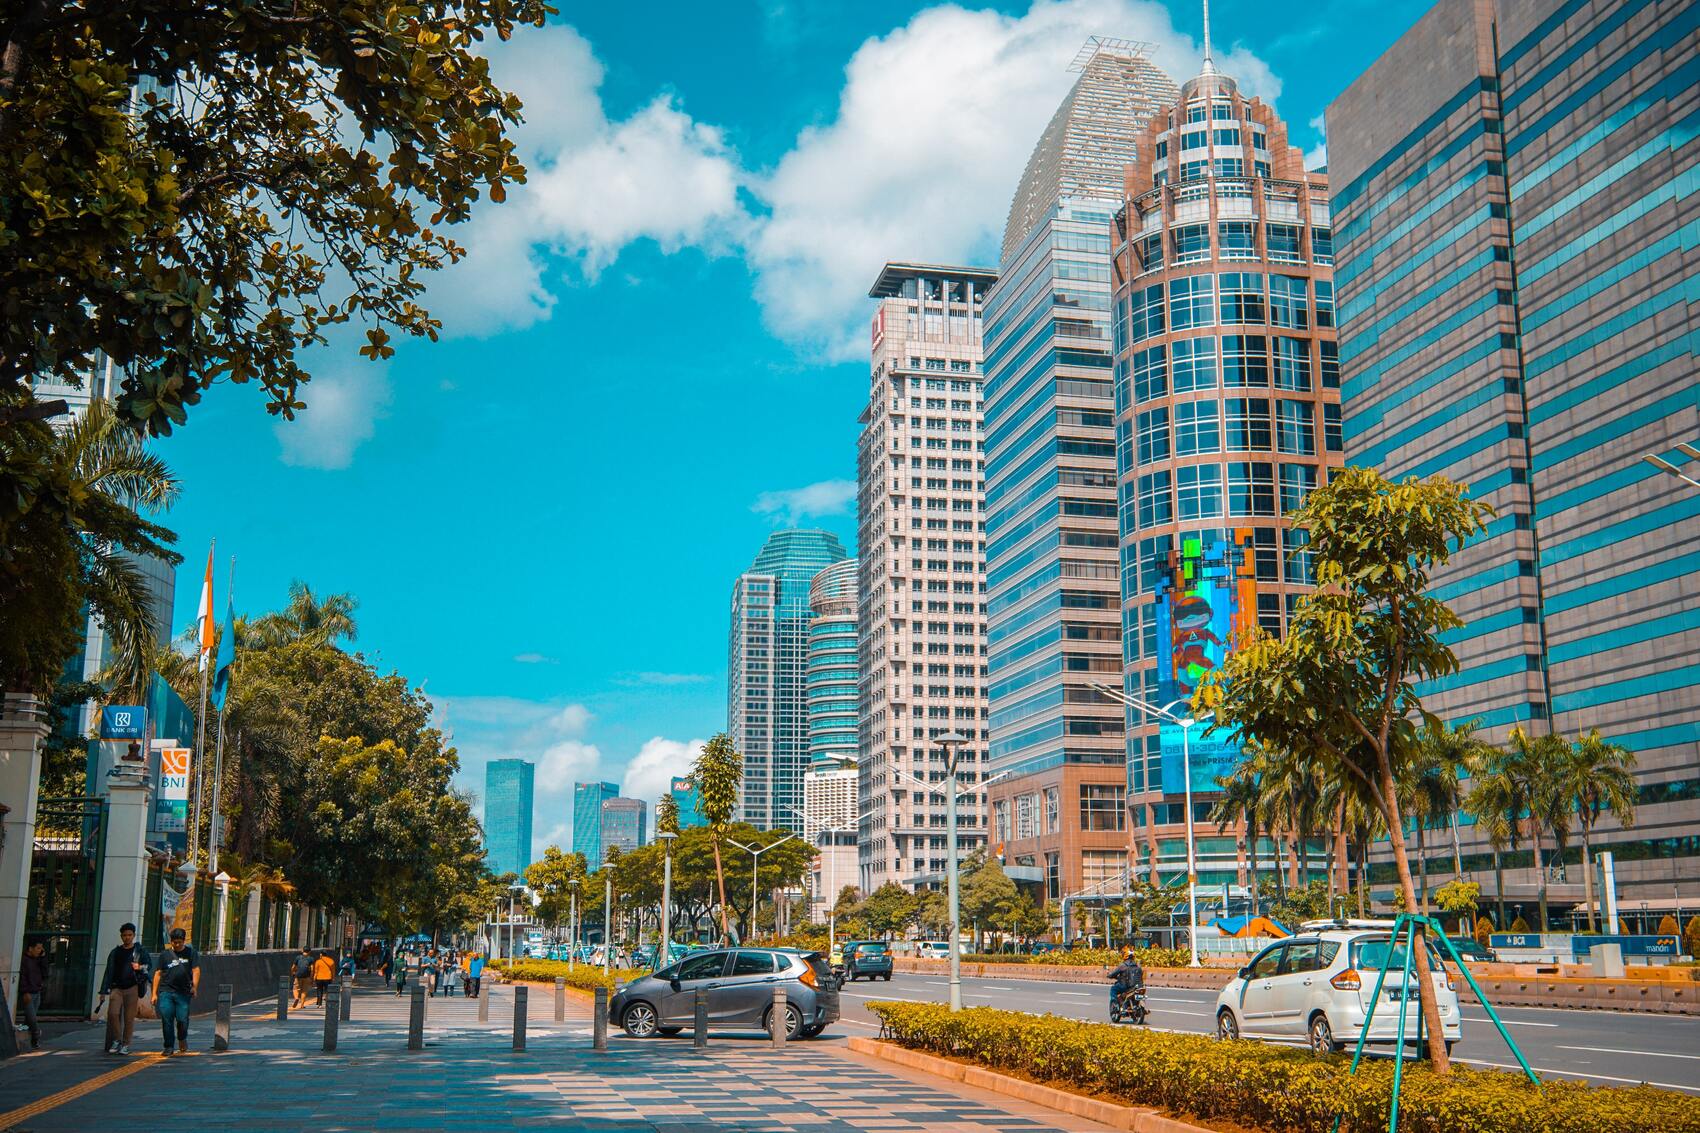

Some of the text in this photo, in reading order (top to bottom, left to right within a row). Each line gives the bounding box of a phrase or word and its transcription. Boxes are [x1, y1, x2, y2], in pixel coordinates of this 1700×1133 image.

[161, 777, 185, 788] BNI
[674, 782, 691, 790] AIA
[1513, 936, 1526, 946] BCA
